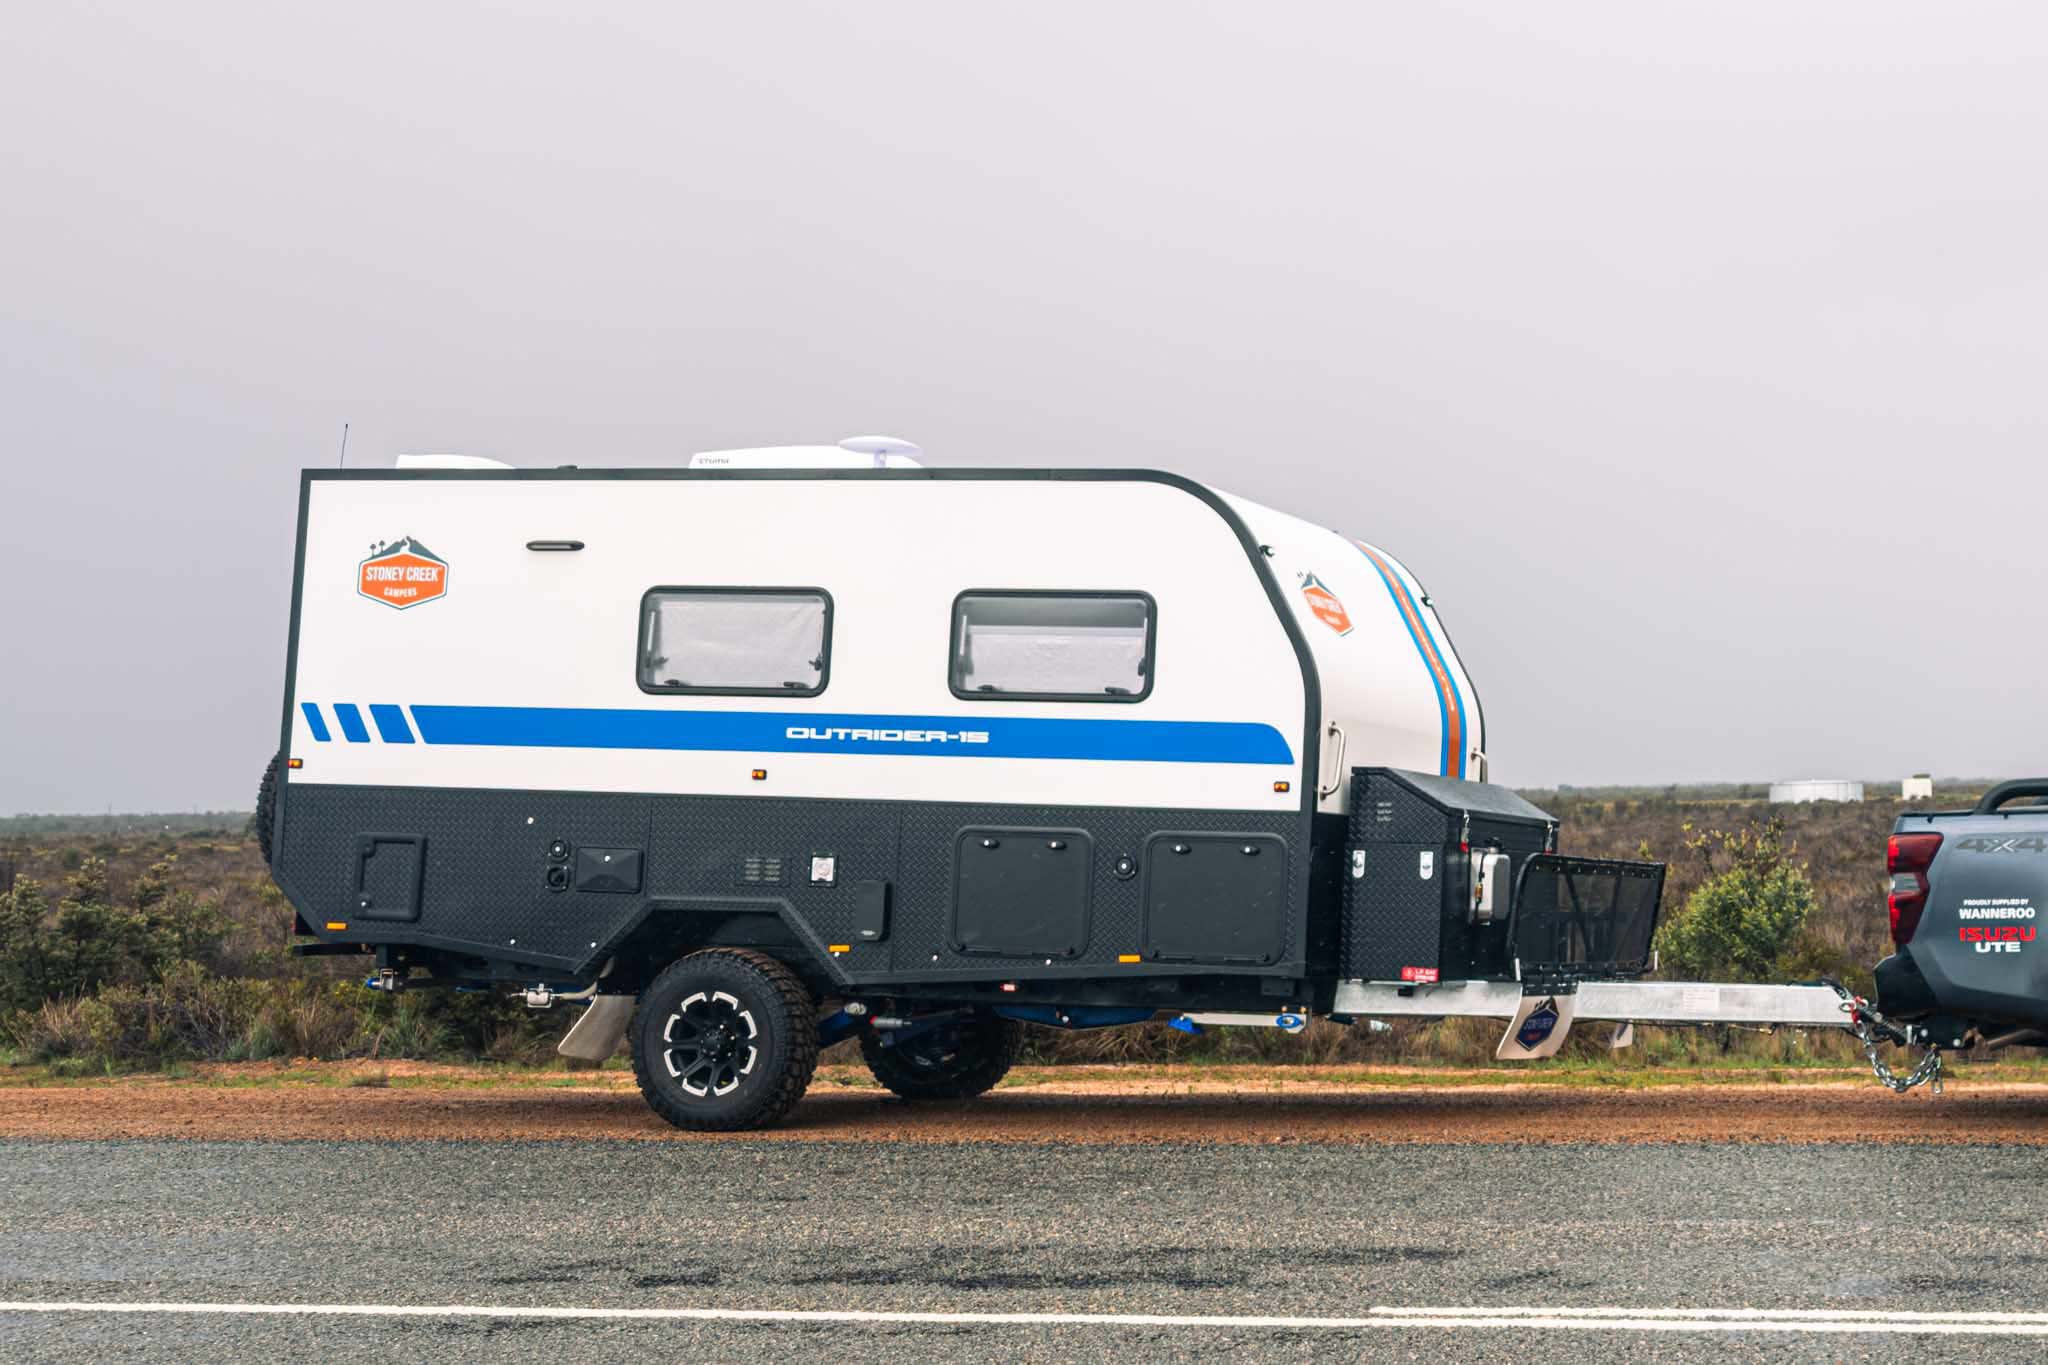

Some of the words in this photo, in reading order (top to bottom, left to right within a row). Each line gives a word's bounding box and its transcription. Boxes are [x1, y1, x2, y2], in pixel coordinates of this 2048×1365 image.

[366, 566, 404, 581] STONEY
[406, 566, 438, 582] CREEK
[384, 587, 416, 598] CAMPERS
[786, 727, 990, 744] OUTRIDER-15
[1991, 898, 2019, 906] SUPPLIED
[1958, 907, 2036, 920] WANNEROO
[1959, 926, 2037, 942] ISUZU
[1975, 941, 2021, 953] UTE
